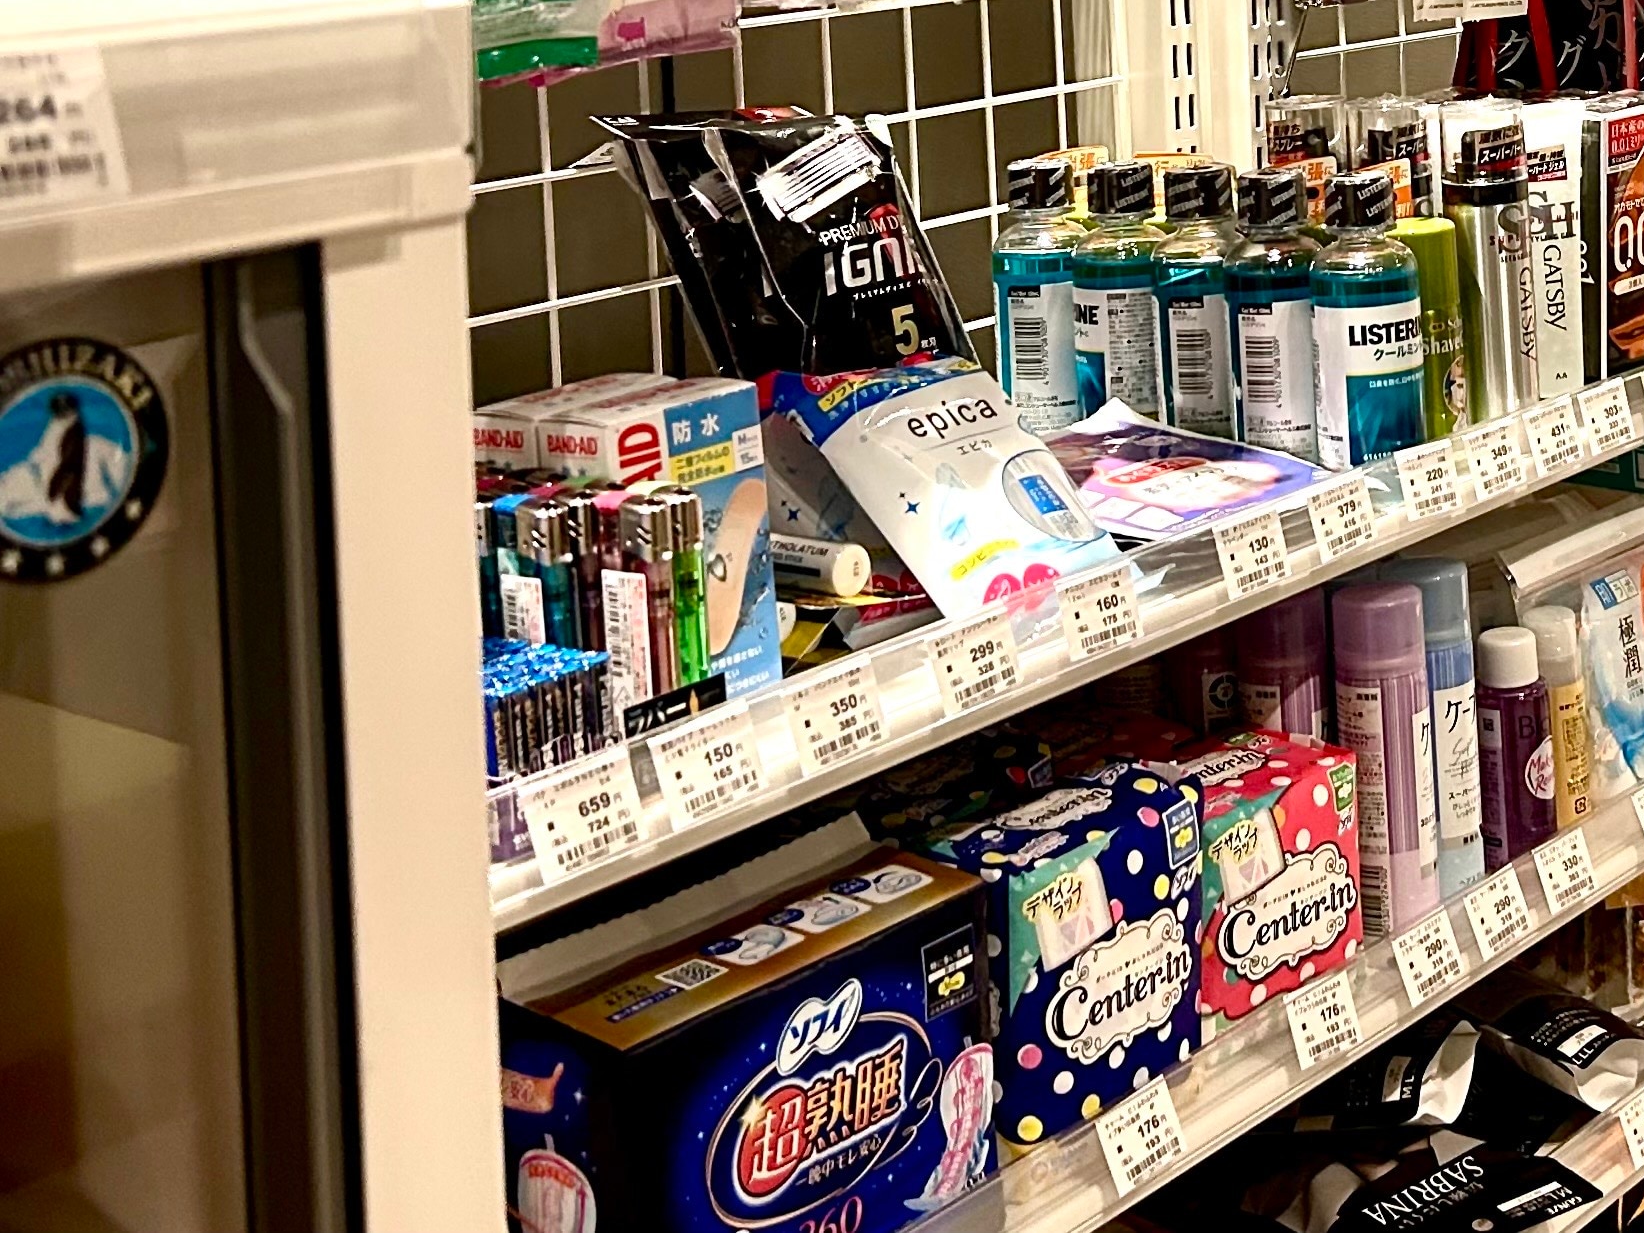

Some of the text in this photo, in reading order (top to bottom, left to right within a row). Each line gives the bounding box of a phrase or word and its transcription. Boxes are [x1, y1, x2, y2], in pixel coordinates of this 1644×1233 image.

[820, 218, 889, 247] PREMIUM
[1543, 243, 1567, 332] GATSBY
[1519, 266, 1538, 361] GATSBY
[907, 395, 998, 440] epica
[1604, 404, 1619, 420] 303
[671, 413, 720, 446] 防水
[1551, 423, 1567, 438] 431
[546, 432, 599, 457] BAND-AID
[957, 438, 993, 456] エピカ
[1425, 467, 1444, 482] 220
[1337, 501, 1357, 518] 379
[1248, 536, 1270, 554] 130
[1096, 593, 1120, 612] 160
[969, 640, 996, 663] 299
[1617, 615, 1643, 677] 極潤
[829, 694, 858, 717] 350
[704, 742, 734, 766] 150
[1200, 749, 1266, 782] nter-in
[713, 765, 734, 782] 165
[578, 791, 611, 818] 659
[587, 816, 611, 834] 724
[1211, 820, 1260, 857] デザイン
[1233, 827, 1260, 859] ラップ
[1562, 854, 1579, 871] 330
[1025, 874, 1076, 919] デザイン
[1052, 890, 1085, 920] ラップ
[1493, 893, 1511, 915] 290
[1223, 877, 1356, 961] Center-in
[1425, 939, 1443, 958] 290
[1051, 947, 1191, 1043] Center-in
[1319, 1004, 1340, 1021] 176
[789, 999, 851, 1056] ソフィ
[1326, 1021, 1340, 1034] 193
[1402, 1072, 1415, 1100] ML
[750, 1041, 906, 1185] 超熟睡
[1136, 1114, 1160, 1138] 176
[1146, 1136, 1161, 1150] 193
[795, 1132, 883, 1186] 一晩中モレ安心
[1361, 1154, 1484, 1227] SABRINA
